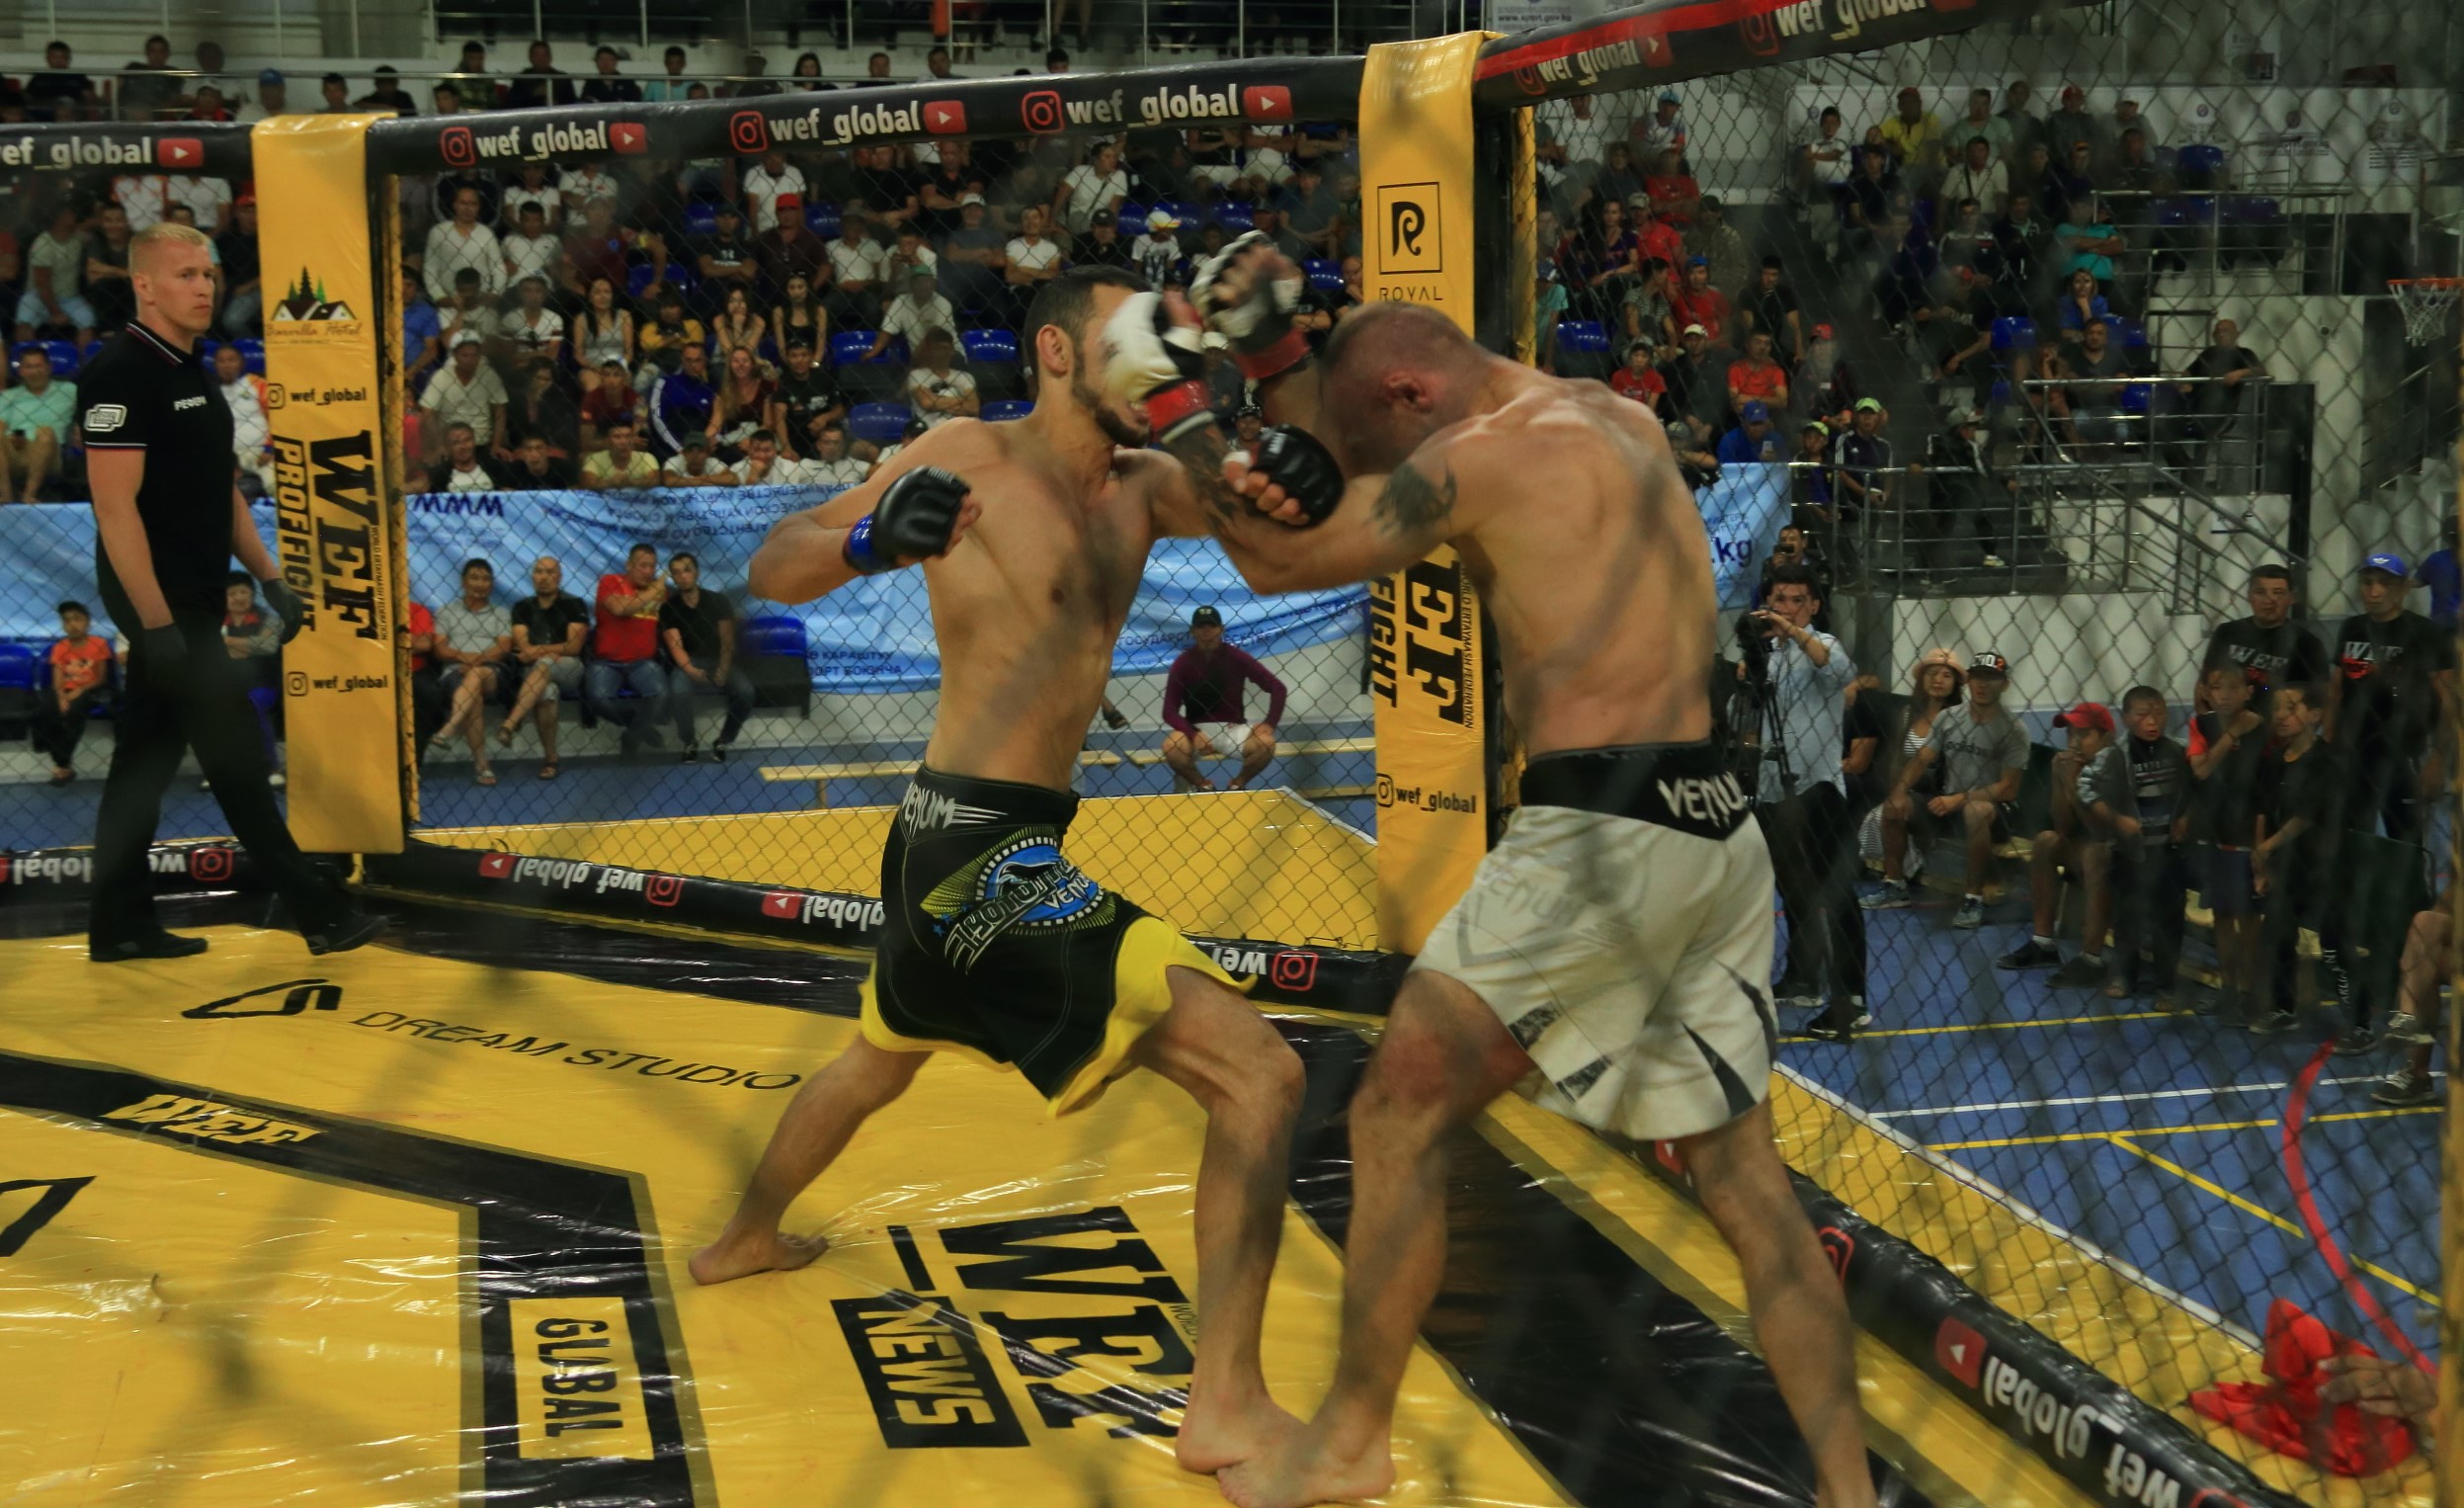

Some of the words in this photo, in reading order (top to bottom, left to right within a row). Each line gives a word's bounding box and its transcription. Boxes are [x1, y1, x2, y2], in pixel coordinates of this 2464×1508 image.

[770, 101, 922, 146] wef_global
[1066, 84, 1240, 127] wef_global
[0, 135, 152, 171] ef_global
[475, 120, 609, 161] wef_global
[1379, 286, 1443, 301] ROYAL
[289, 386, 368, 406] wef_global
[309, 429, 380, 640] WEF
[1405, 559, 1463, 725] EF
[1461, 606, 1473, 667] ERTAYMASH
[311, 674, 388, 693] wef_global
[1463, 667, 1475, 729] FEDERATION
[1395, 787, 1477, 814] wef_global
[1656, 770, 1744, 830] VENU
[1043, 872, 1091, 909] VENU
[350, 1011, 571, 1057] DREAM
[563, 1048, 802, 1091] STUDIO
[535, 1317, 624, 1438] GLOBAL
[857, 1299, 997, 1425] NEWS
